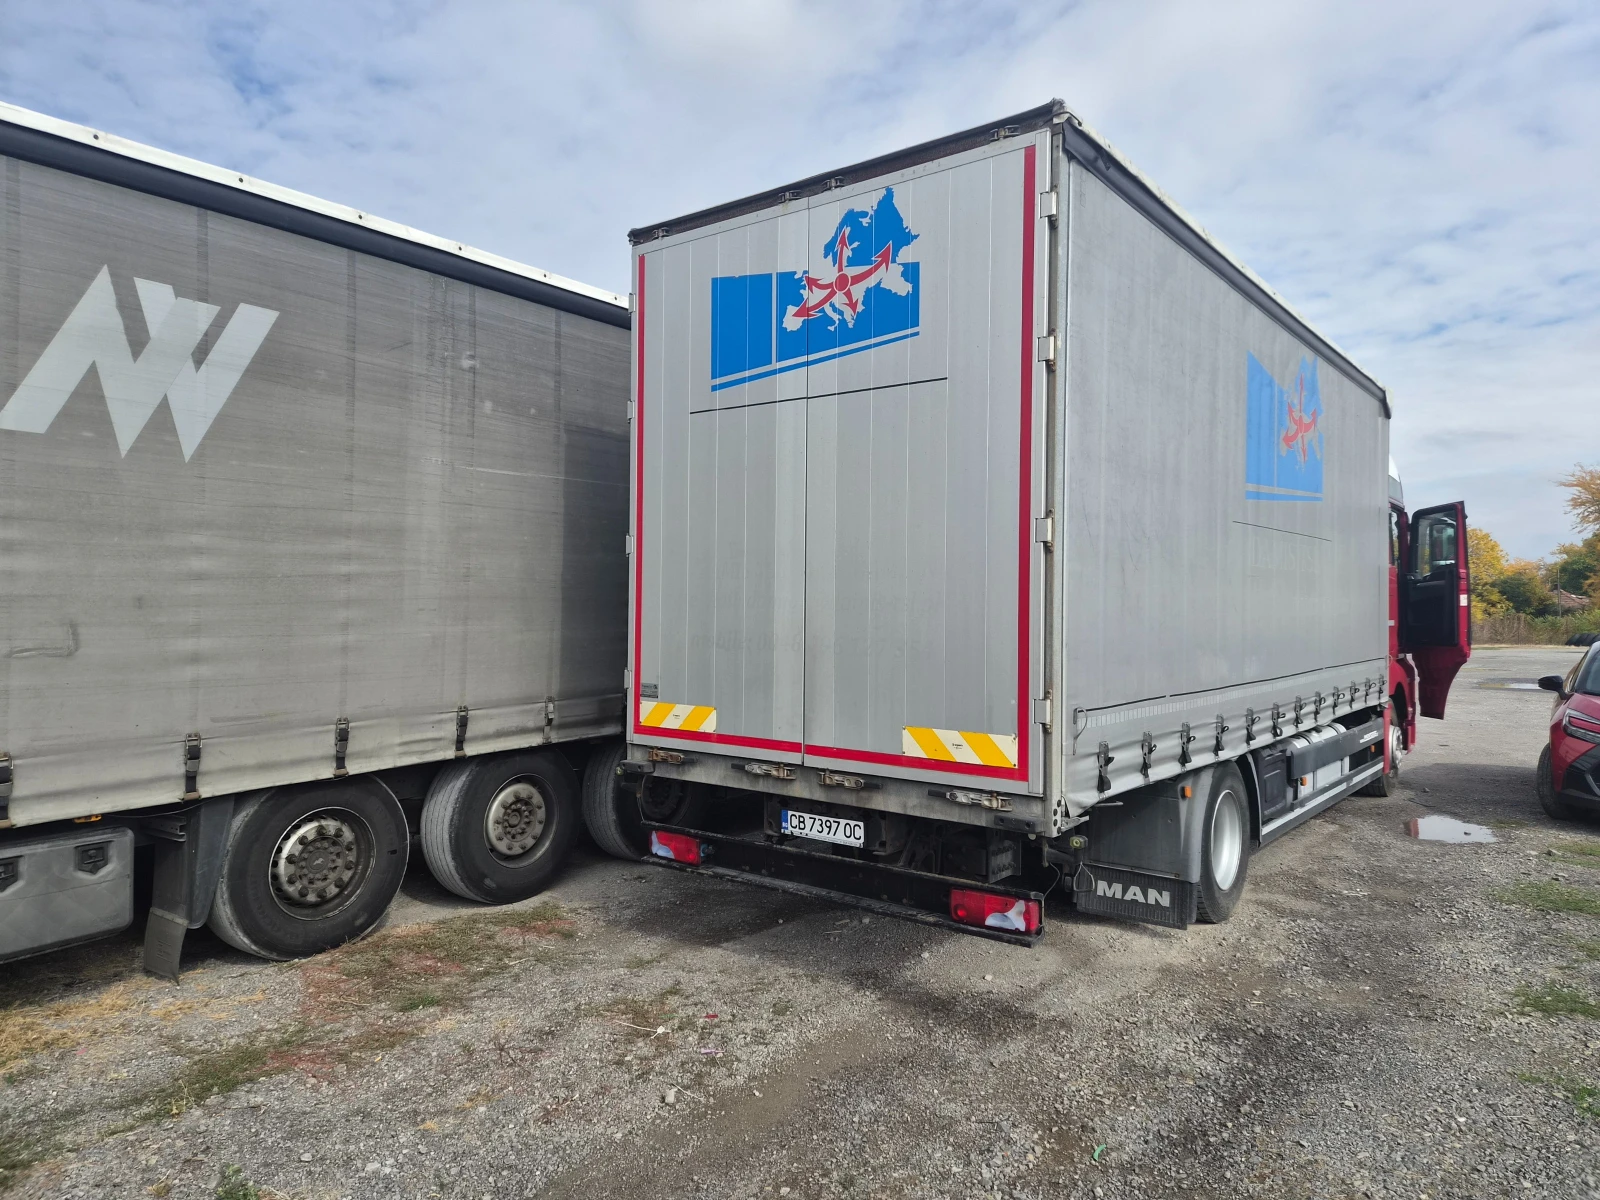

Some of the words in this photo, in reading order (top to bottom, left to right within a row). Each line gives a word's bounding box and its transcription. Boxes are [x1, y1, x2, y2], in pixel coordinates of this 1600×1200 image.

[789, 814, 806, 830] CB
[809, 817, 841, 837] 7397
[1096, 879, 1171, 908] MAN
